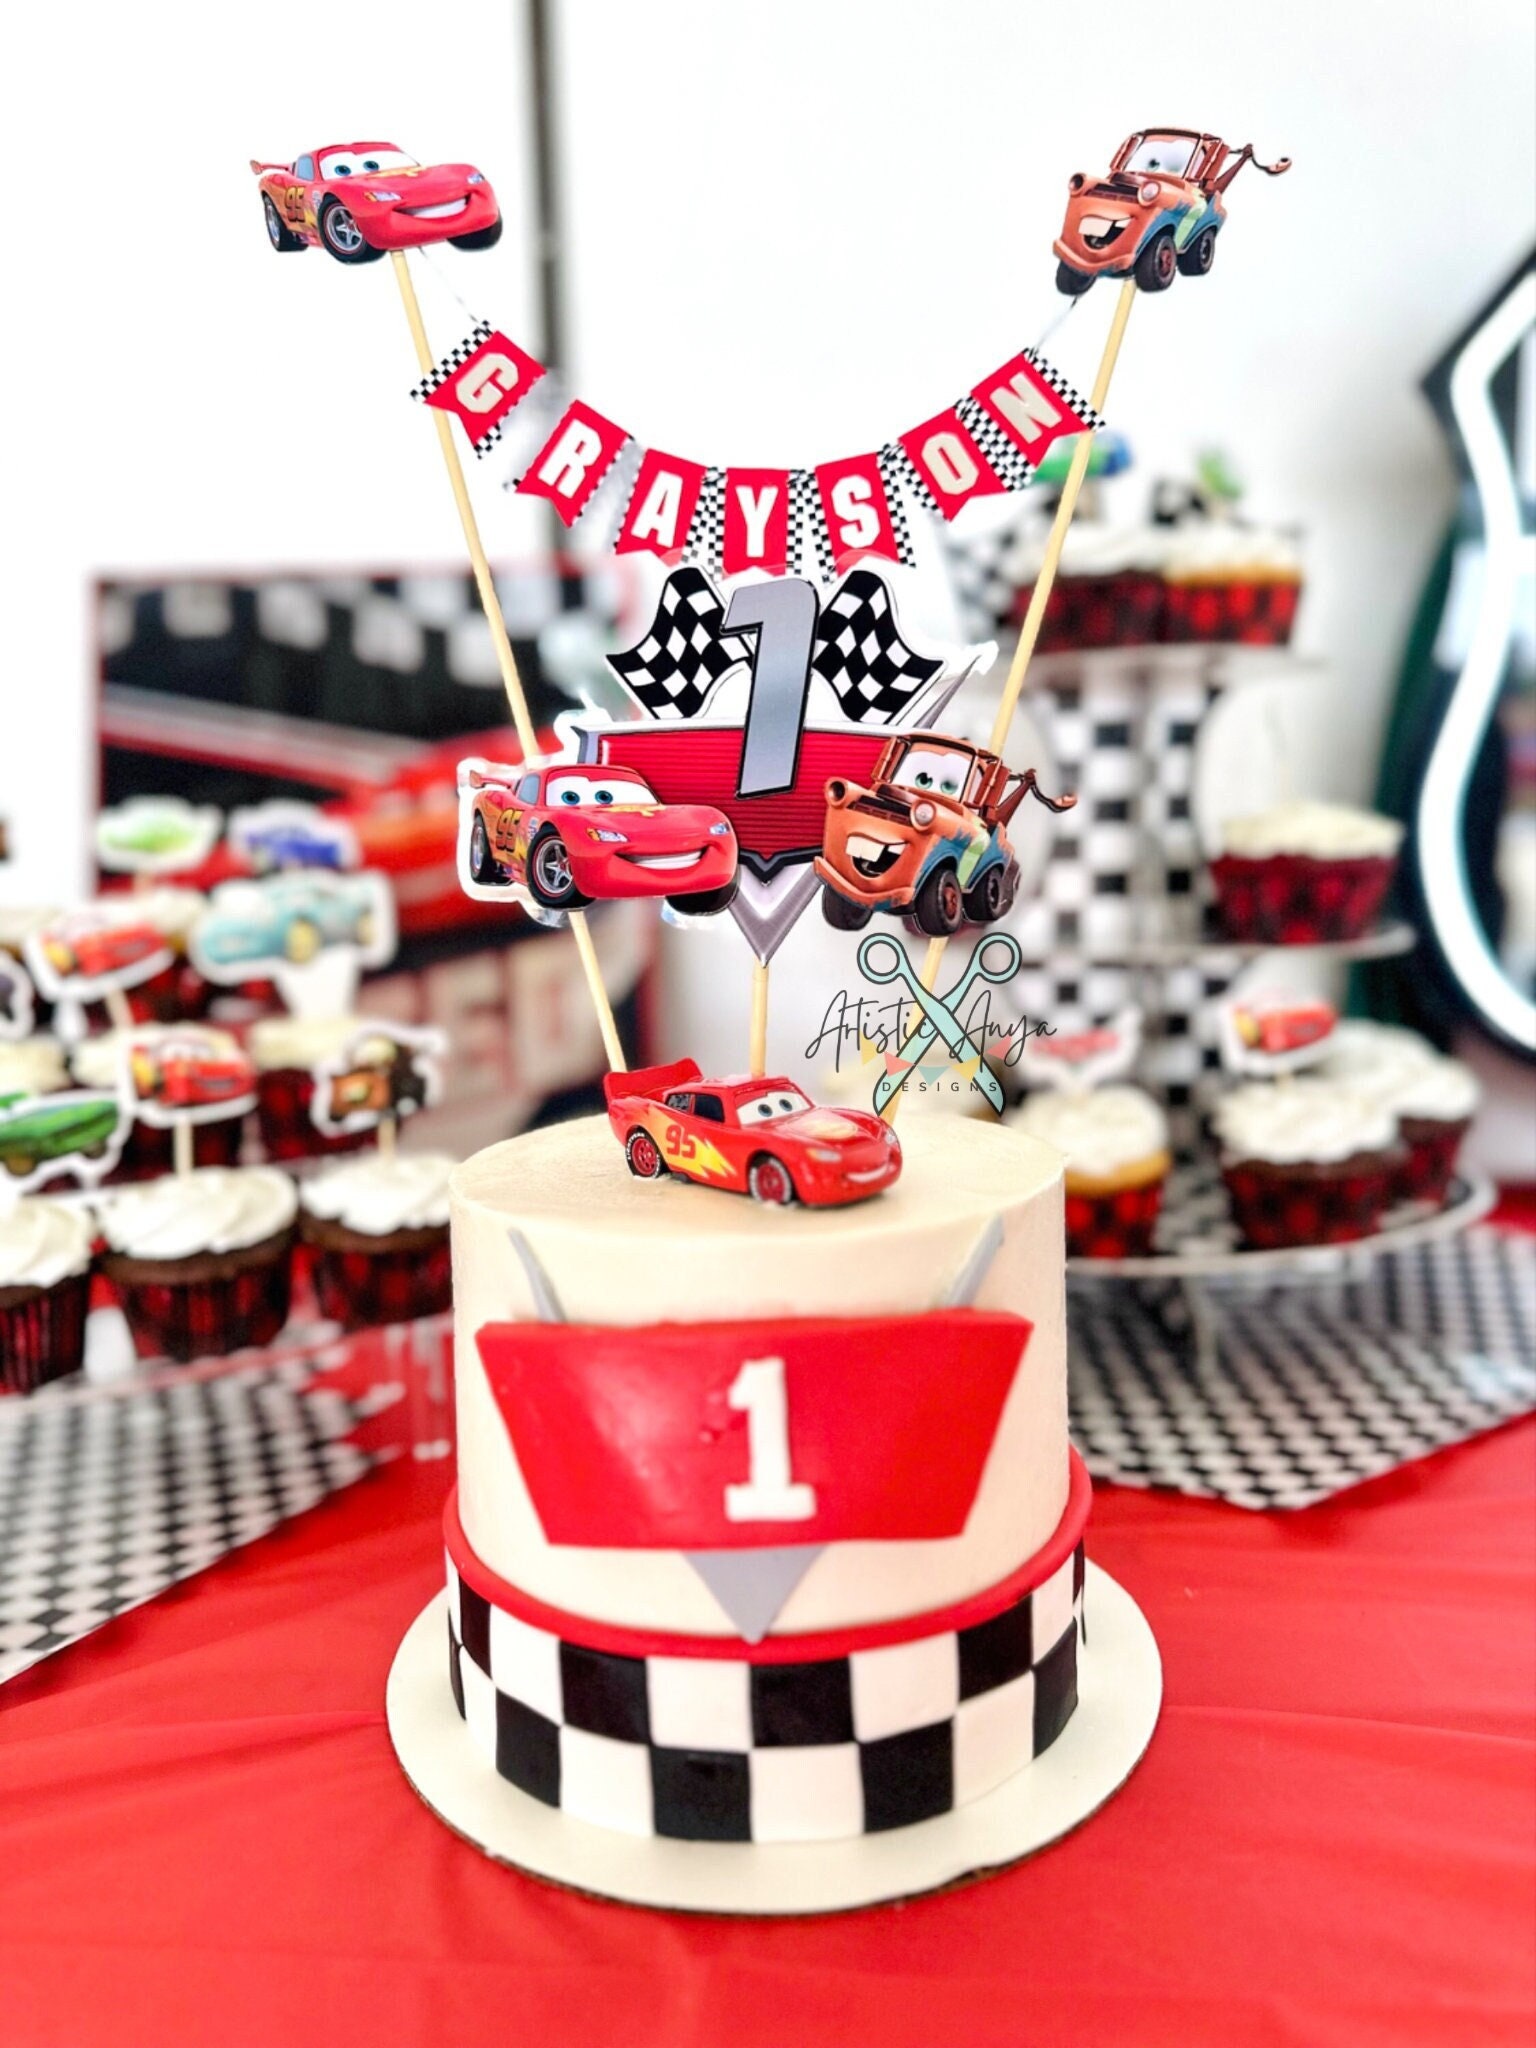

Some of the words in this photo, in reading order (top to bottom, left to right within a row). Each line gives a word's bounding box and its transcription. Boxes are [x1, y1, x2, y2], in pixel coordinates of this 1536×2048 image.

[455, 352, 1061, 558] GRAYSON
[719, 577, 818, 799] 1
[665, 1124, 696, 1160] 95
[723, 1355, 817, 1523] 1
